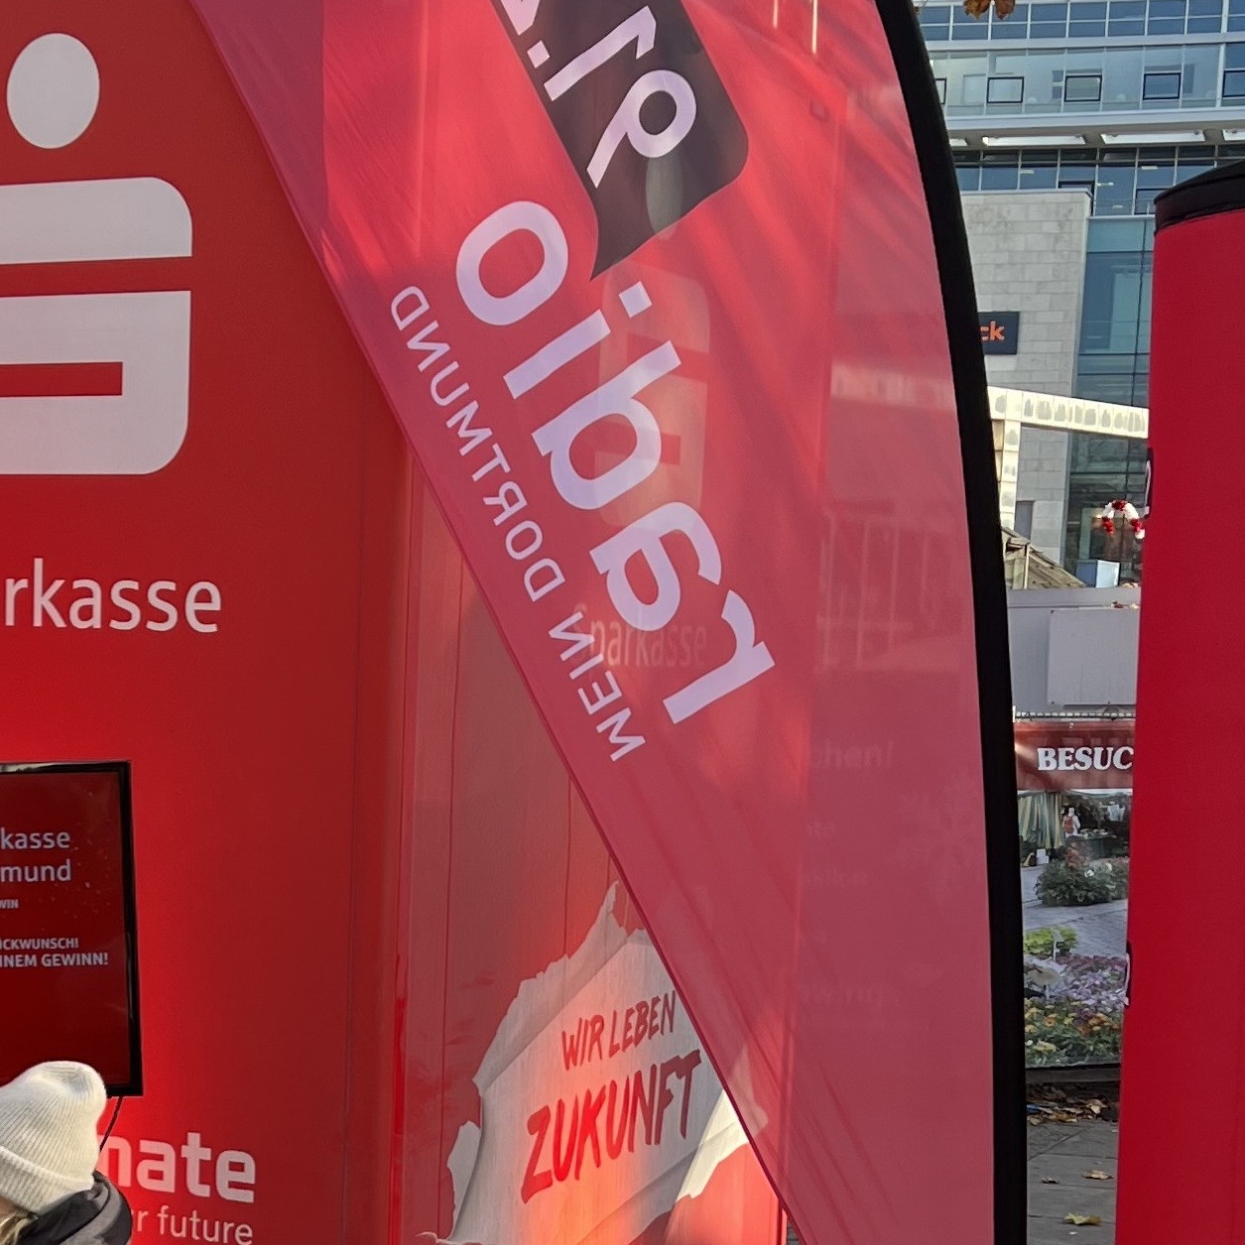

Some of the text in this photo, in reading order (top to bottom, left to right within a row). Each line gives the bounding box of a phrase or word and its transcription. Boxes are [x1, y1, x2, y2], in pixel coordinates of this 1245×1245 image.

[41, 952, 109, 967] GEWINN!
[562, 990, 677, 1070] WIR LEBEN
[521, 1049, 702, 1204] ZUKUNFT
